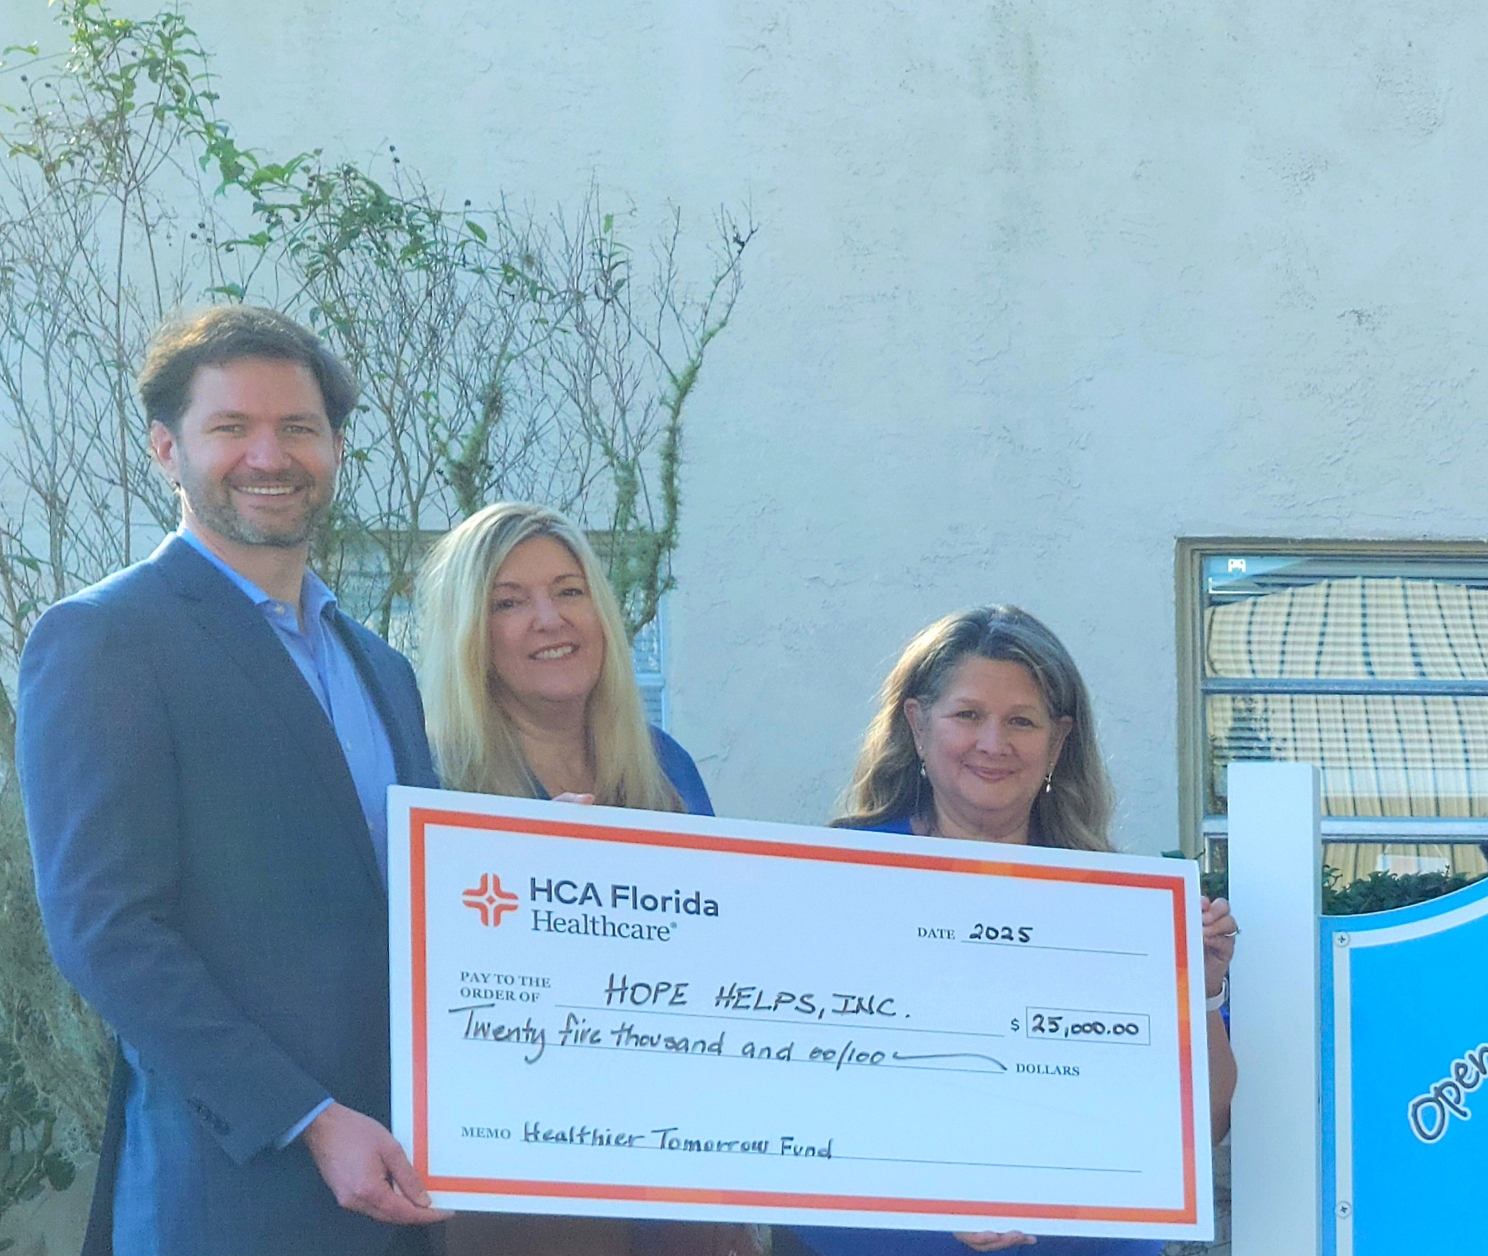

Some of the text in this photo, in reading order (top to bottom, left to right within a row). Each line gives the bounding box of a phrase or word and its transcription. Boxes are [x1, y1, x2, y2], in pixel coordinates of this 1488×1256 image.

[530, 876, 720, 917] HCA Florida
[917, 926, 956, 940] DATE
[969, 923, 1034, 943] 2025
[460, 971, 551, 989] PAY TO THE
[604, 973, 690, 1006] HOPE
[460, 987, 541, 1003] ORDER OF
[449, 1003, 546, 1064] Twenty
[610, 1021, 726, 1056] thousand
[741, 1041, 795, 1062] and
[1010, 1017, 1021, 1032] $
[1031, 1013, 1140, 1038] 25,000.00
[1016, 1063, 1081, 1077] DOLLARS
[460, 1125, 512, 1140] MEMO
[522, 1121, 834, 1160] Healthier Tomorrow Fund
